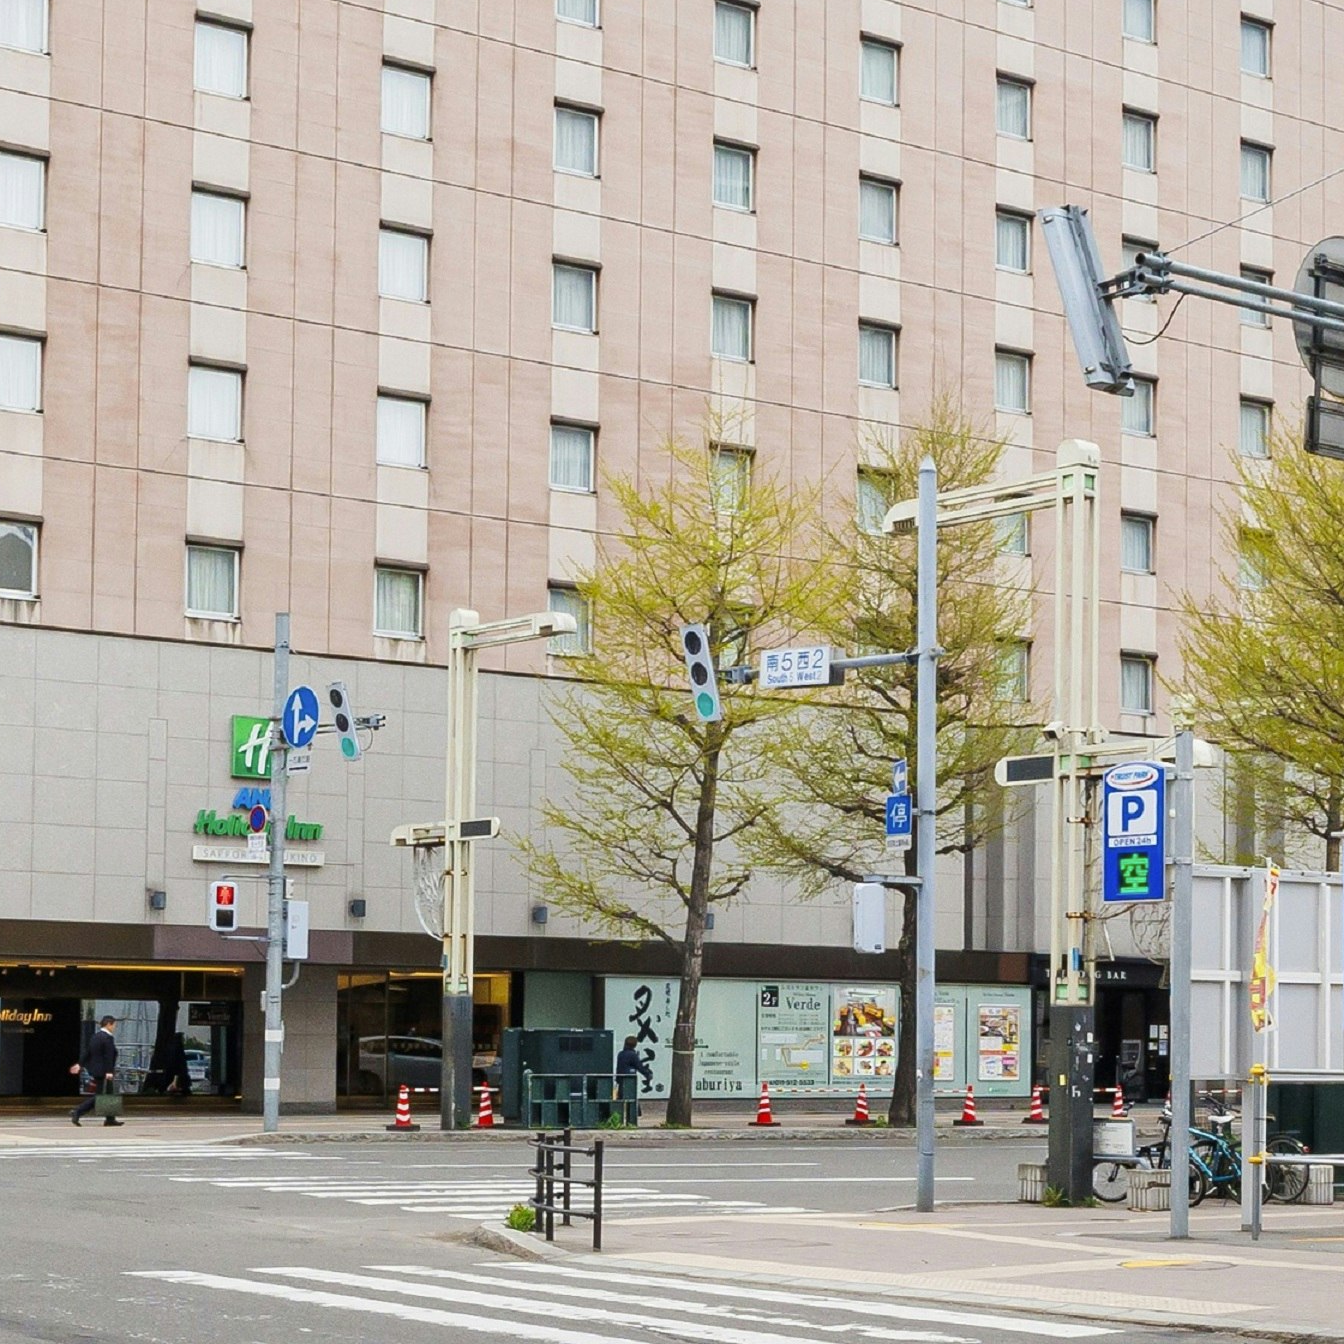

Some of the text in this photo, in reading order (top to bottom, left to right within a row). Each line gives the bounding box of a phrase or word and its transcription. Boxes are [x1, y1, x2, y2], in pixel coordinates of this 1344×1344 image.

[767, 673, 788, 685] South
[797, 671, 816, 682] West
[232, 787, 271, 810] AN
[889, 803, 908, 829] 停
[1121, 795, 1145, 832] P
[285, 814, 323, 840] Inn
[1113, 837, 1152, 847] OPEN 24h
[1119, 853, 1149, 893] 空
[786, 996, 822, 1011] Verde
[32, 1008, 53, 1022] Inn
[695, 1077, 743, 1092] aburiya
